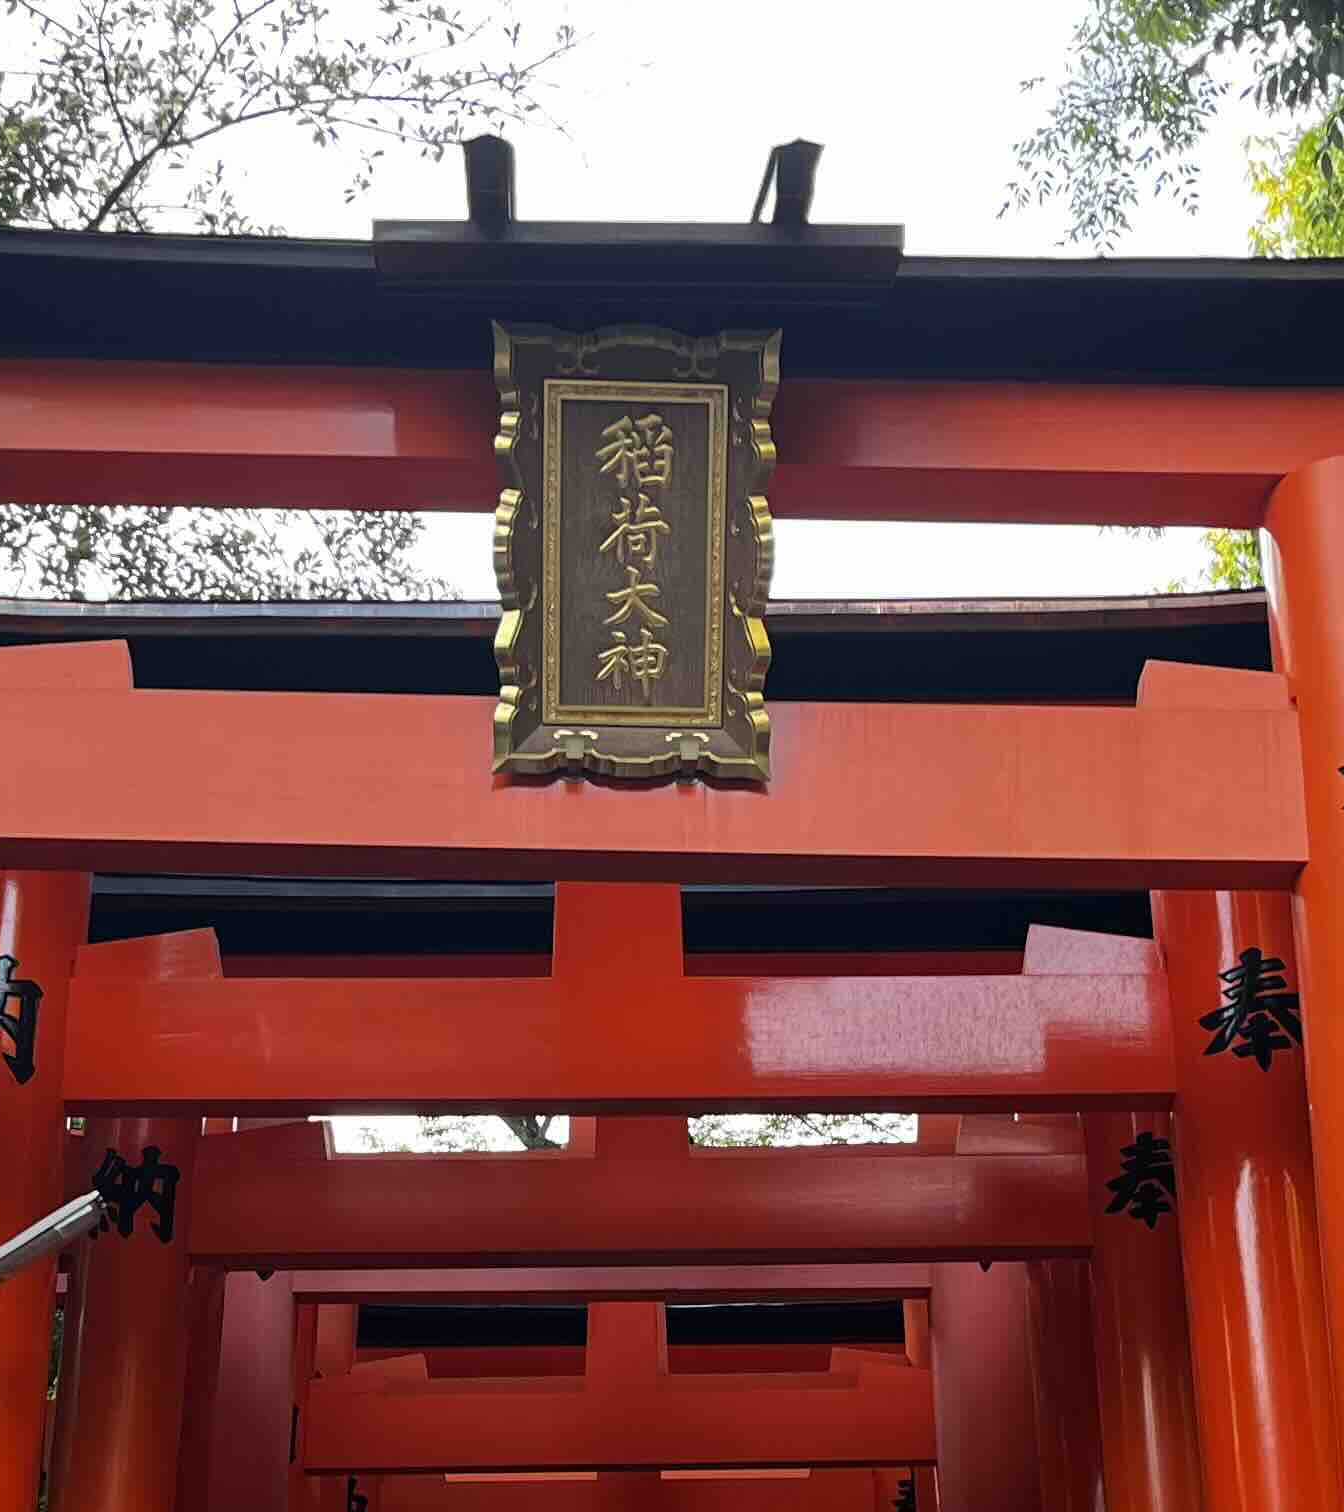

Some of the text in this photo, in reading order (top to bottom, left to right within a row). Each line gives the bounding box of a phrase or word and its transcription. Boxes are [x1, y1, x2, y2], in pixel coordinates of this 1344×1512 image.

[1199, 947, 1303, 1072] 奉
[90, 1145, 181, 1243] 納
[1104, 1131, 1177, 1229] 奉
